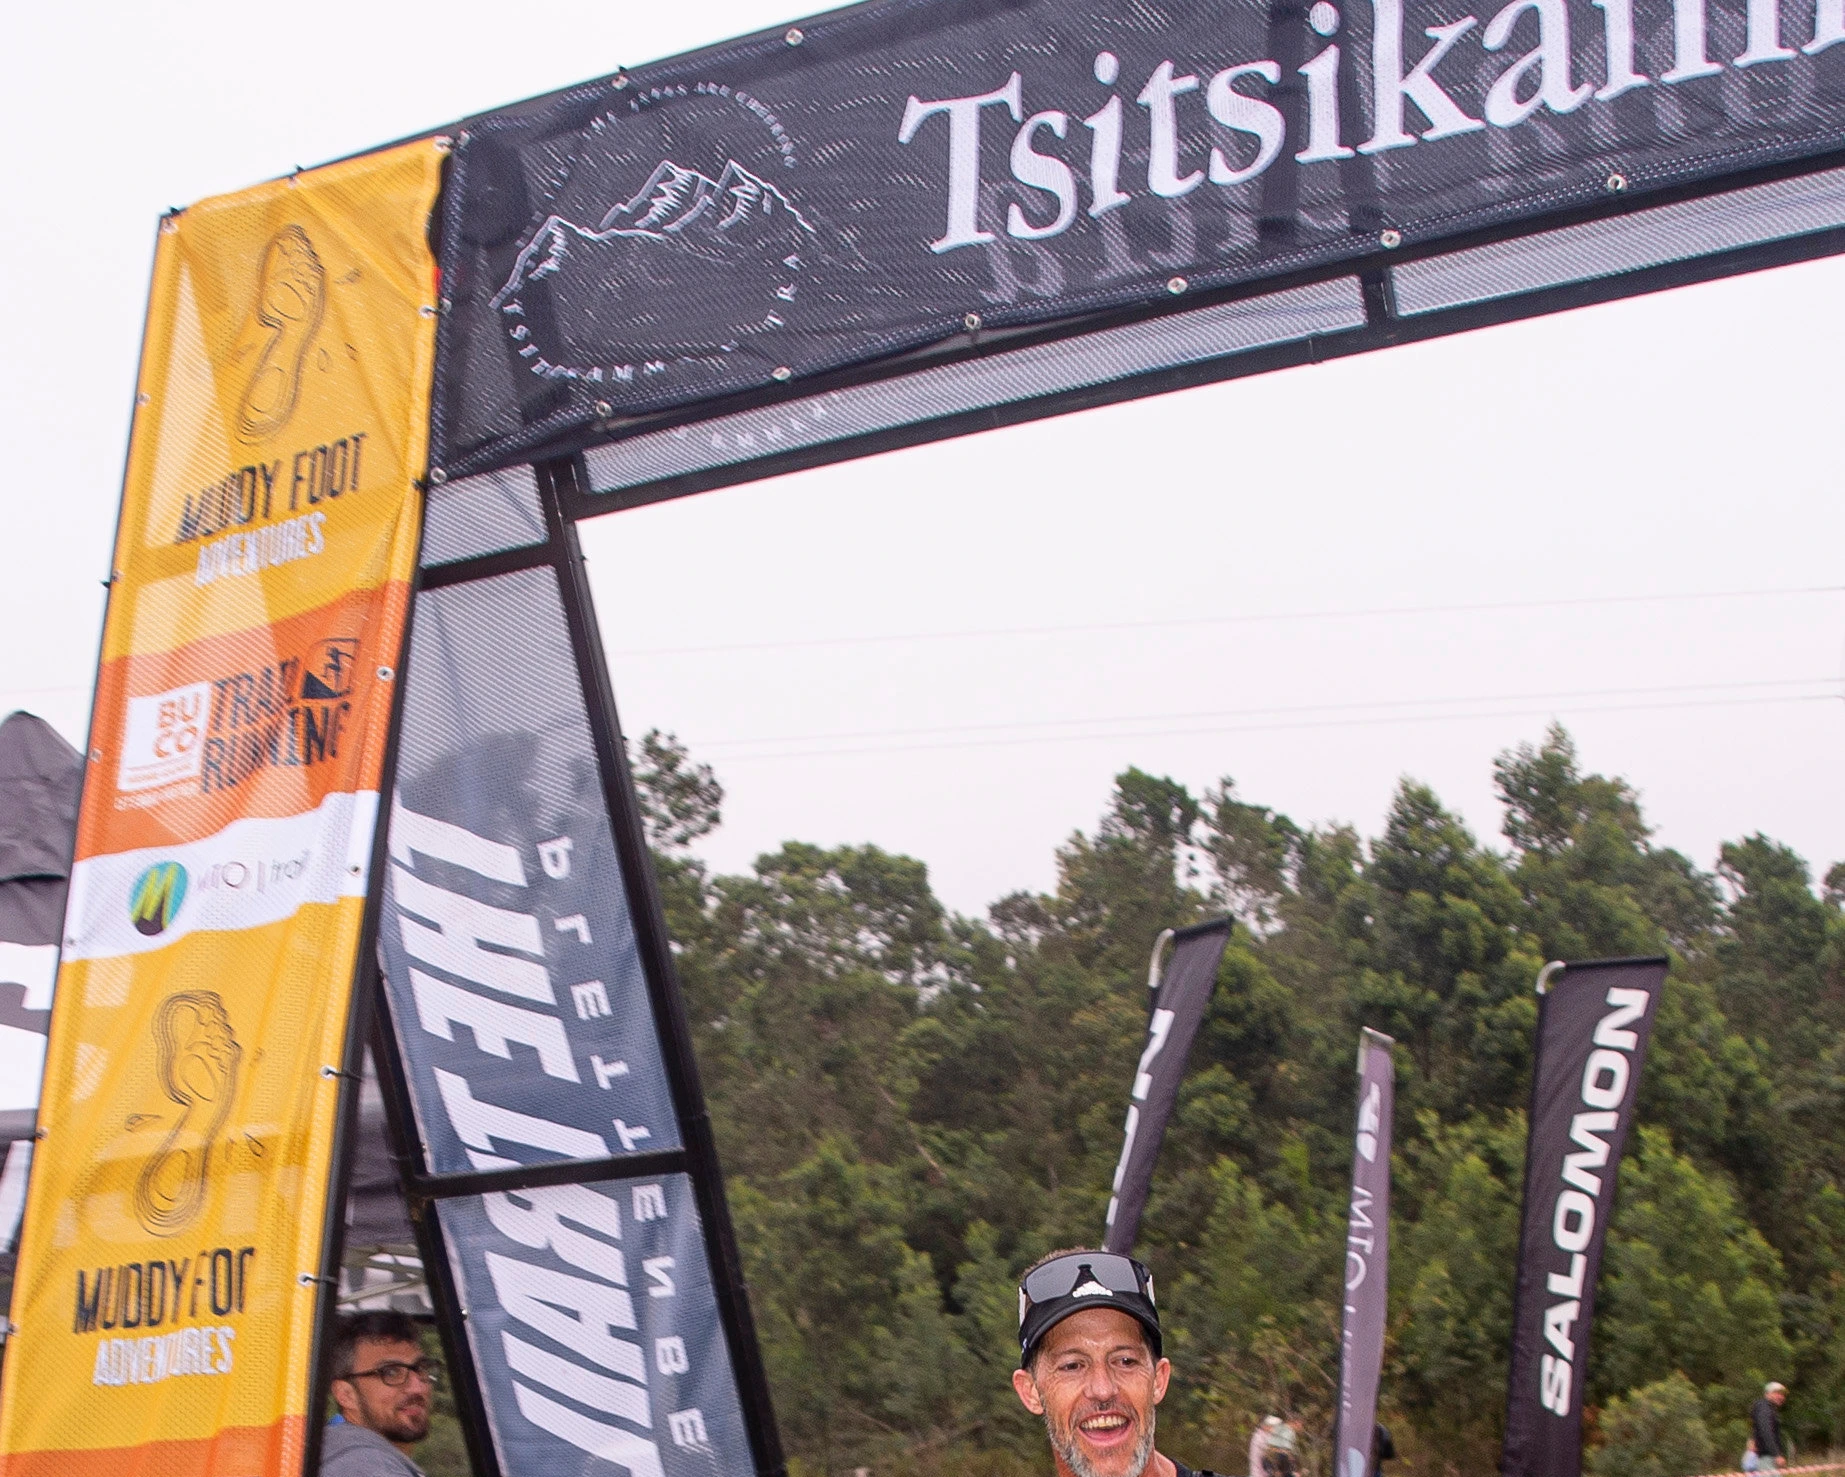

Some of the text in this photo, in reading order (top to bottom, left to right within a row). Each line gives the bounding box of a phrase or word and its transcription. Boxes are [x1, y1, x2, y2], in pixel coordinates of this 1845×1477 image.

[898, 0, 1845, 254] Tsitsikam
[288, 431, 368, 511] FOOT
[1540, 986, 1650, 1418] SALOMON
[73, 1258, 191, 1335] MUDDY
